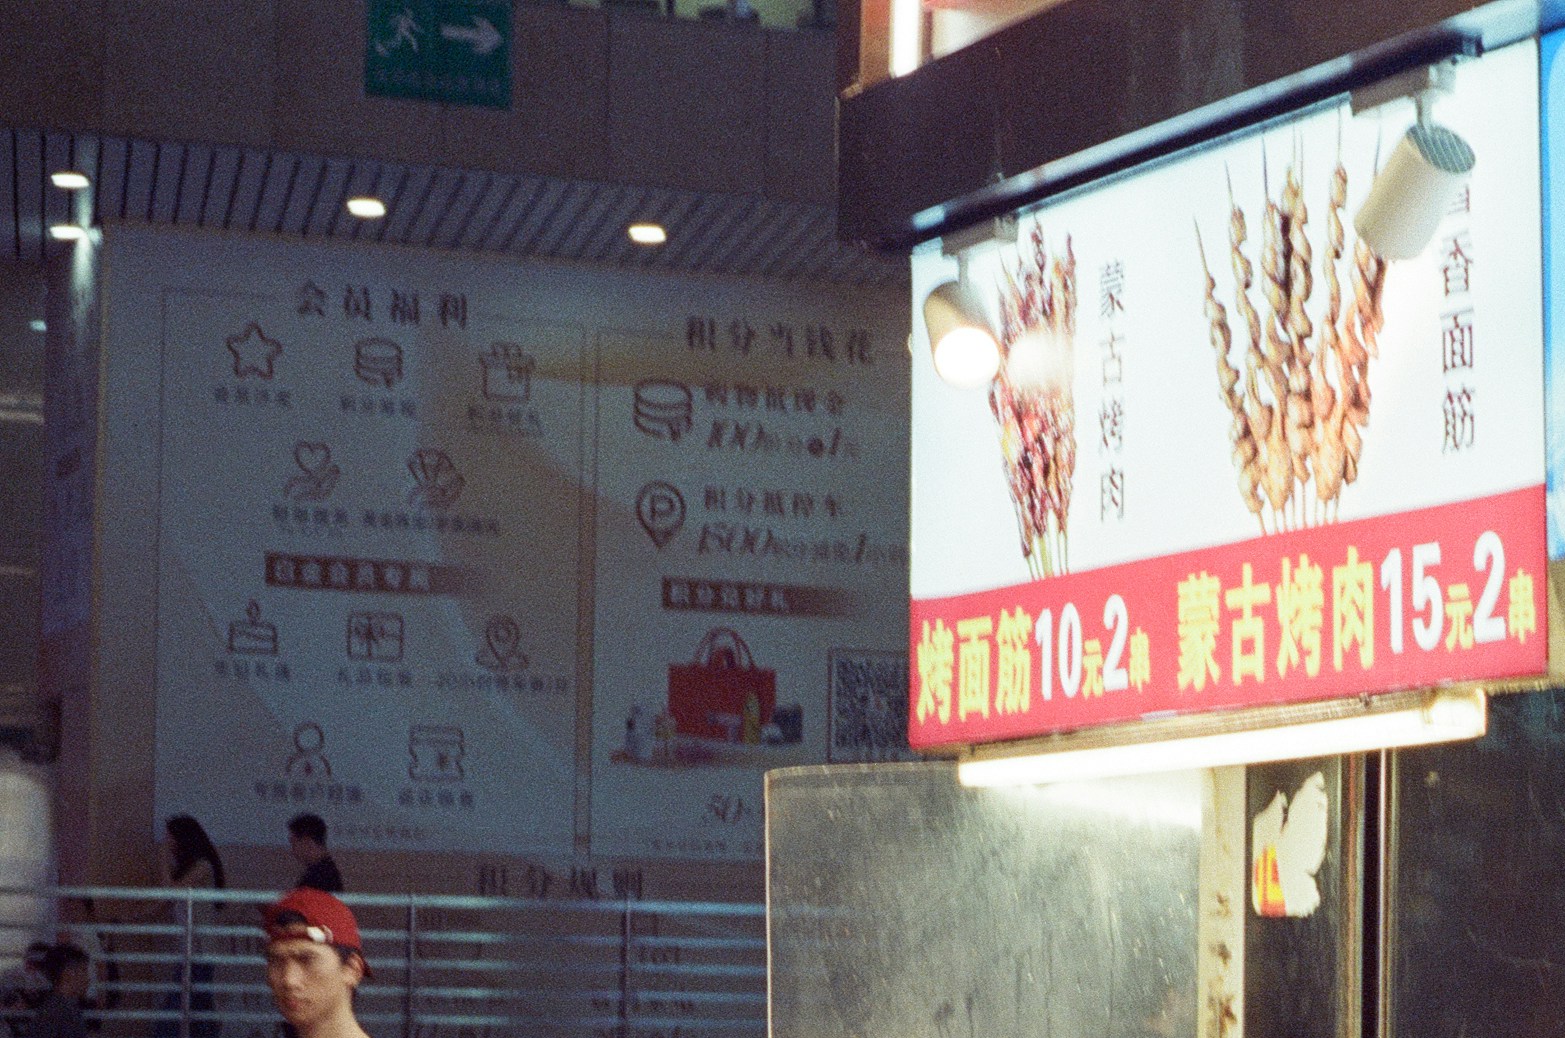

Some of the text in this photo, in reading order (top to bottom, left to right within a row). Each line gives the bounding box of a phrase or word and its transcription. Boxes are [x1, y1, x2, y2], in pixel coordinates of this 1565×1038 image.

[1098, 259, 1124, 522] 蒙古烤肉
[1440, 184, 1475, 454] 香面筋
[917, 594, 1151, 724] 烤面筋10元2串
[1176, 531, 1538, 692] 蒙古烤肉15元2串
